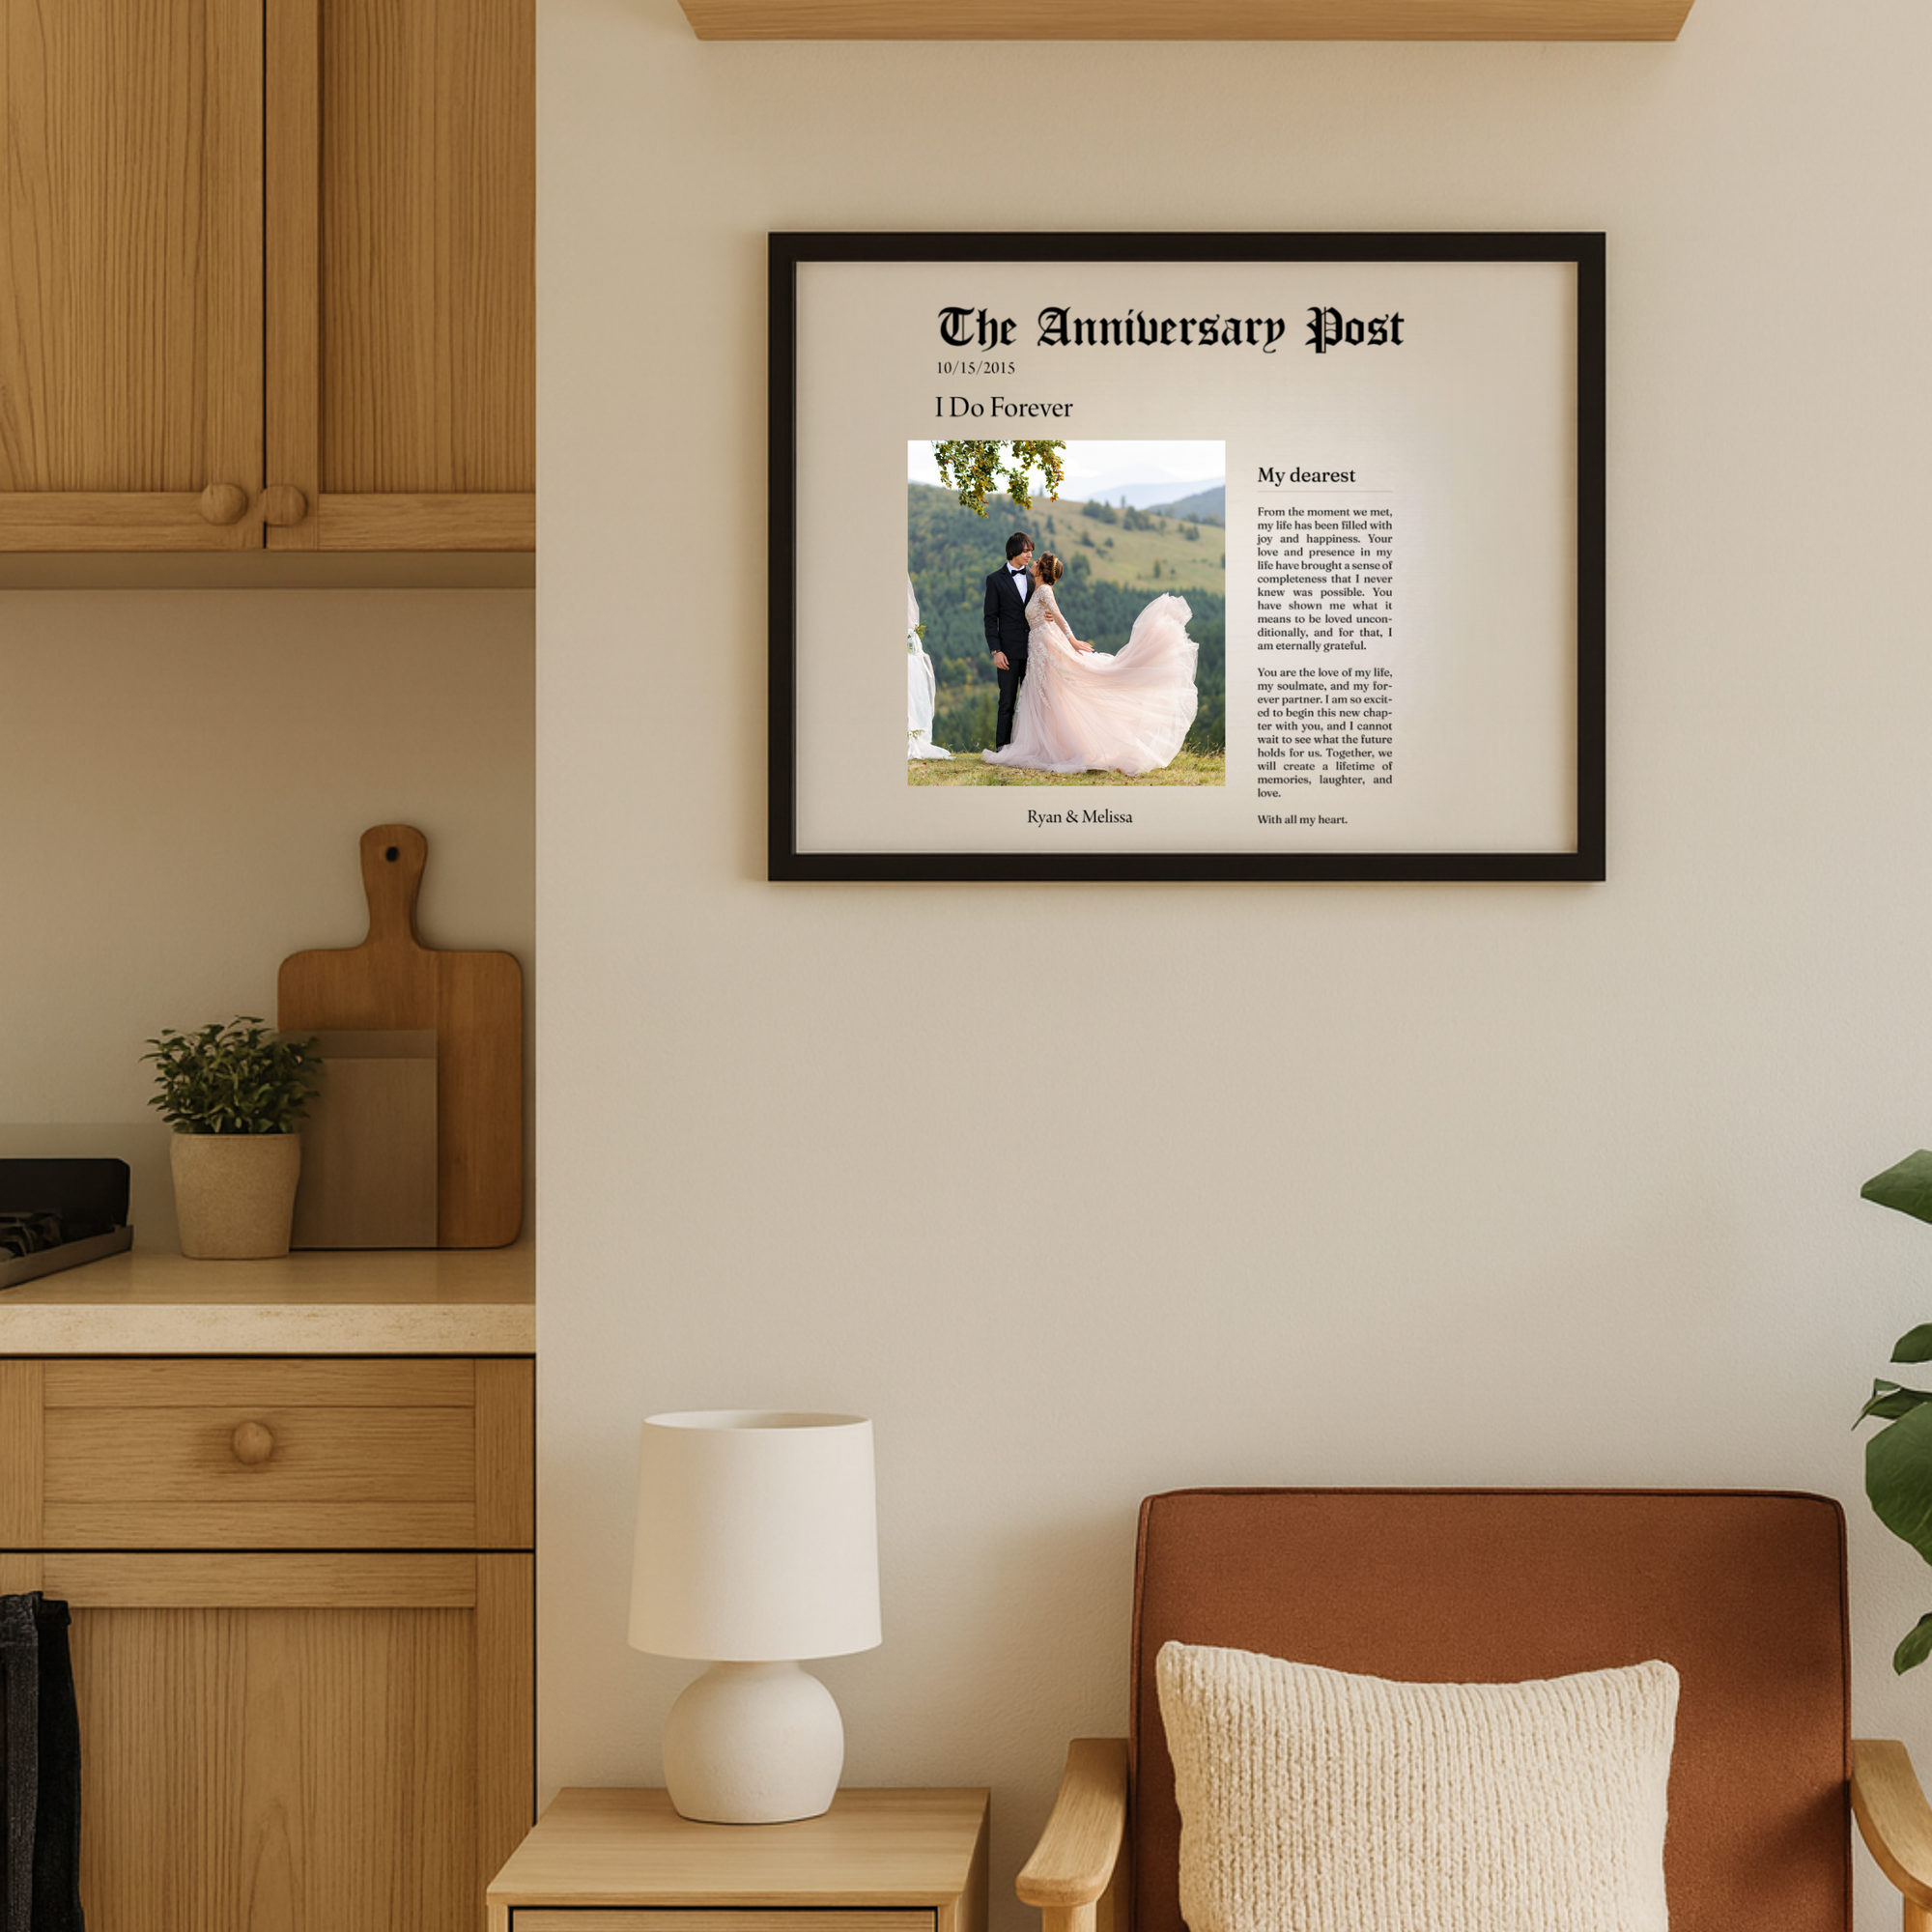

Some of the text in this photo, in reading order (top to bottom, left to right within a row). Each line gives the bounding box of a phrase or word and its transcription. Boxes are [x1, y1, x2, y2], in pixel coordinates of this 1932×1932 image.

[938, 306, 1405, 354] The Anniversary Post
[938, 360, 1016, 375] 10/15/2015
[935, 396, 1074, 418] I Do Forever
[1257, 466, 1357, 487] My dearest
[1257, 507, 1285, 516] From
[1288, 507, 1305, 516] the
[1369, 509, 1392, 518] met,
[1257, 520, 1392, 533] my life has been filled with
[1256, 534, 1393, 546] joy and happiness. Your
[1257, 546, 1392, 559] love and presence in my
[1257, 560, 1274, 570] life
[1276, 560, 1300, 570] have
[1301, 560, 1342, 573] brought
[1381, 560, 1393, 570] of
[1257, 573, 1328, 586] completeness
[1331, 573, 1352, 584] that
[1355, 573, 1360, 584] I
[1257, 587, 1285, 597] knew
[1320, 587, 1365, 599] possible.
[1372, 587, 1392, 597] You
[1257, 600, 1281, 610] have
[1288, 600, 1322, 610] shown
[1352, 600, 1378, 610] what
[1385, 600, 1392, 610] it
[1308, 614, 1321, 624] be
[1325, 614, 1353, 624] loved
[1256, 626, 1392, 640] ditionally, and for that, I
[1276, 640, 1322, 653] eternally
[1323, 640, 1366, 653] grateful.
[1257, 667, 1278, 678] You
[1299, 667, 1316, 678] the
[1318, 667, 1339, 678] love
[1341, 667, 1353, 678] of
[1355, 670, 1371, 680] my
[1373, 667, 1392, 679] life,
[1257, 681, 1392, 693] my soulmate, and my for-
[1281, 696, 1323, 707] partner.
[1325, 694, 1329, 704] I
[1364, 694, 1392, 705] excit-
[1257, 708, 1270, 717] ed
[1285, 708, 1314, 720] begin
[1317, 708, 1336, 717] this
[1363, 707, 1392, 720] chap-
[1257, 722, 1273, 731] ter
[1275, 721, 1298, 731] with
[1301, 723, 1324, 734] you,
[1327, 721, 1346, 731] and
[1349, 721, 1354, 731] I
[1257, 735, 1279, 744] wait
[1281, 736, 1293, 744] to
[1313, 734, 1339, 744] what
[1341, 734, 1359, 744] the
[1361, 734, 1392, 744] future
[1257, 747, 1286, 758] holds
[1289, 747, 1305, 758] for
[1325, 747, 1375, 760] Together,
[1257, 761, 1277, 770] will
[1283, 763, 1315, 771] create
[1335, 761, 1375, 771] lifetime
[1381, 761, 1393, 771] of
[1257, 774, 1392, 787] memories, laughter, and
[1257, 788, 1281, 797] love.
[1027, 808, 1134, 828] Ryan & Melissa
[1257, 814, 1348, 827] With all my heart.
